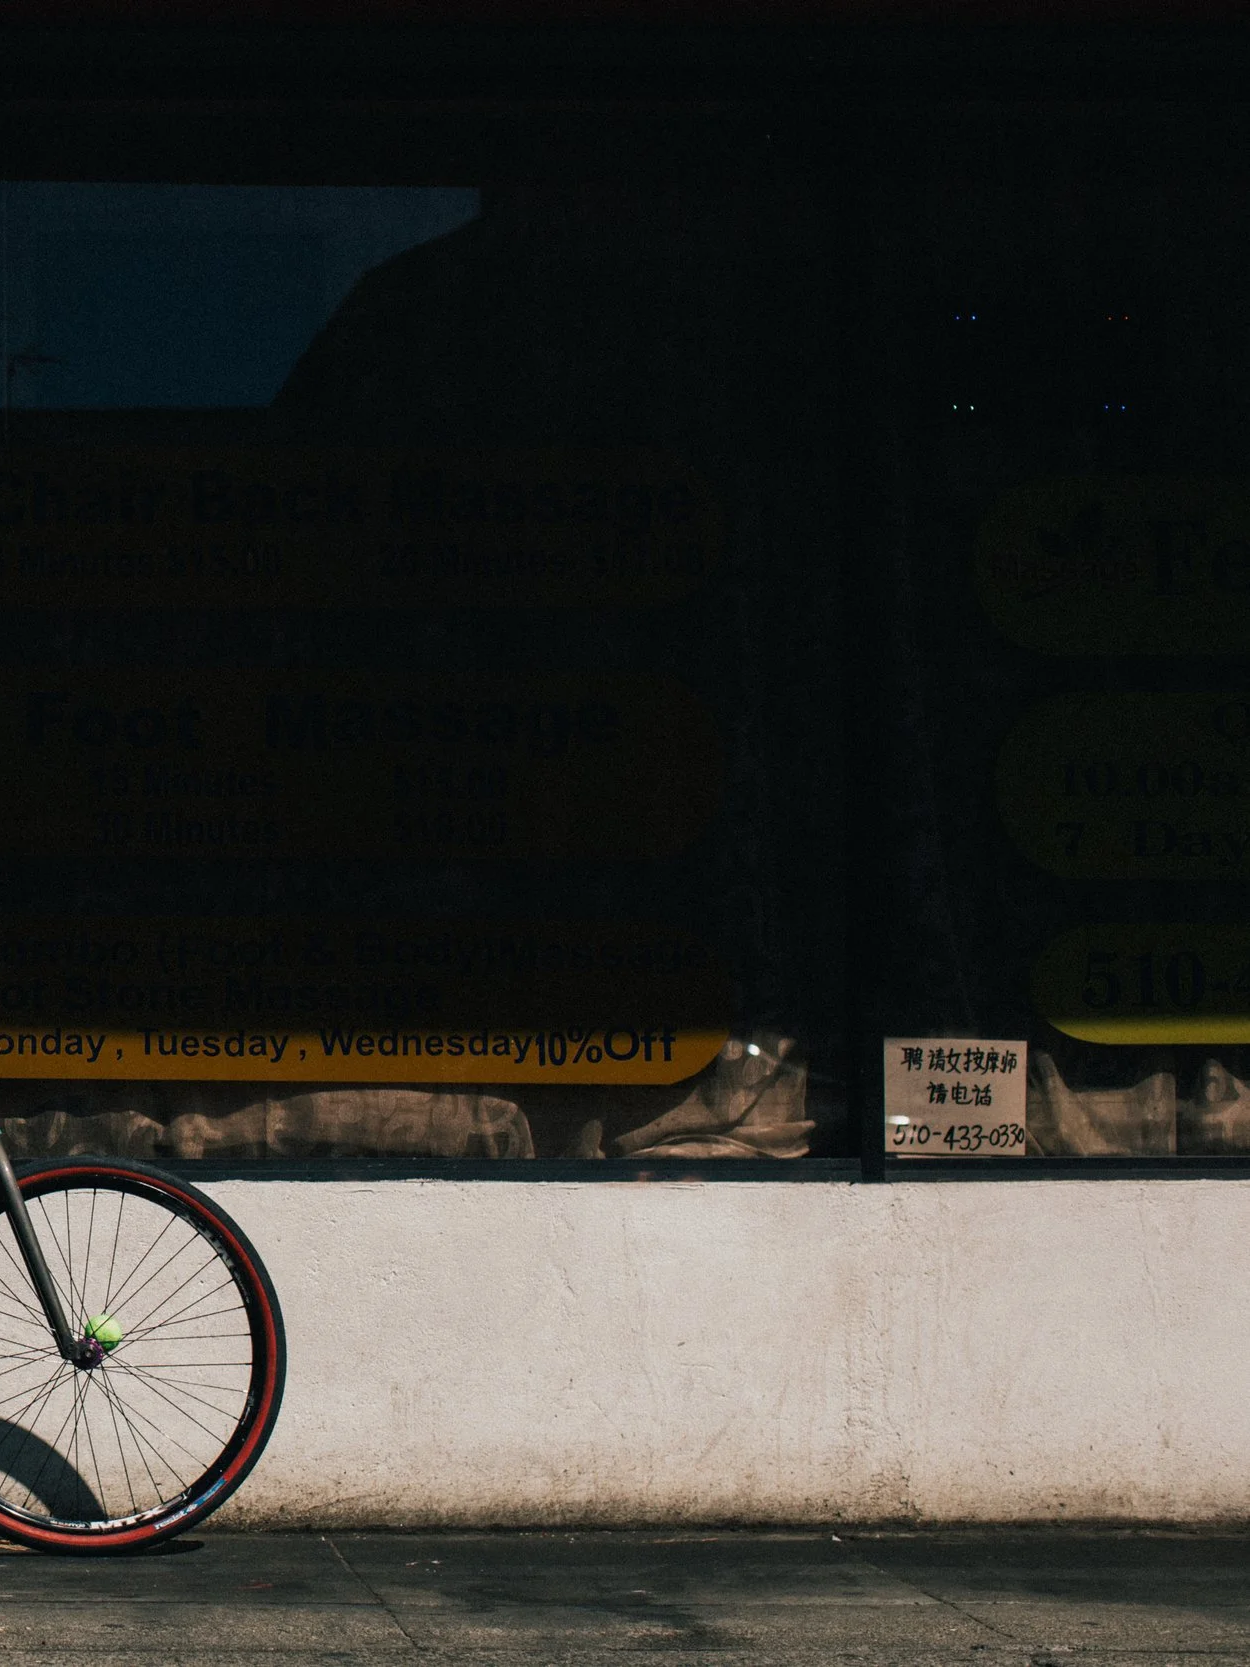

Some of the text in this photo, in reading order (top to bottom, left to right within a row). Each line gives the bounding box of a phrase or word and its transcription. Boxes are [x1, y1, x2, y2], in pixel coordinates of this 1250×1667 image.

[137, 1027, 289, 1063] Tuesday
[319, 1027, 535, 1065] Wednesday
[926, 1081, 993, 1107] 请电话
